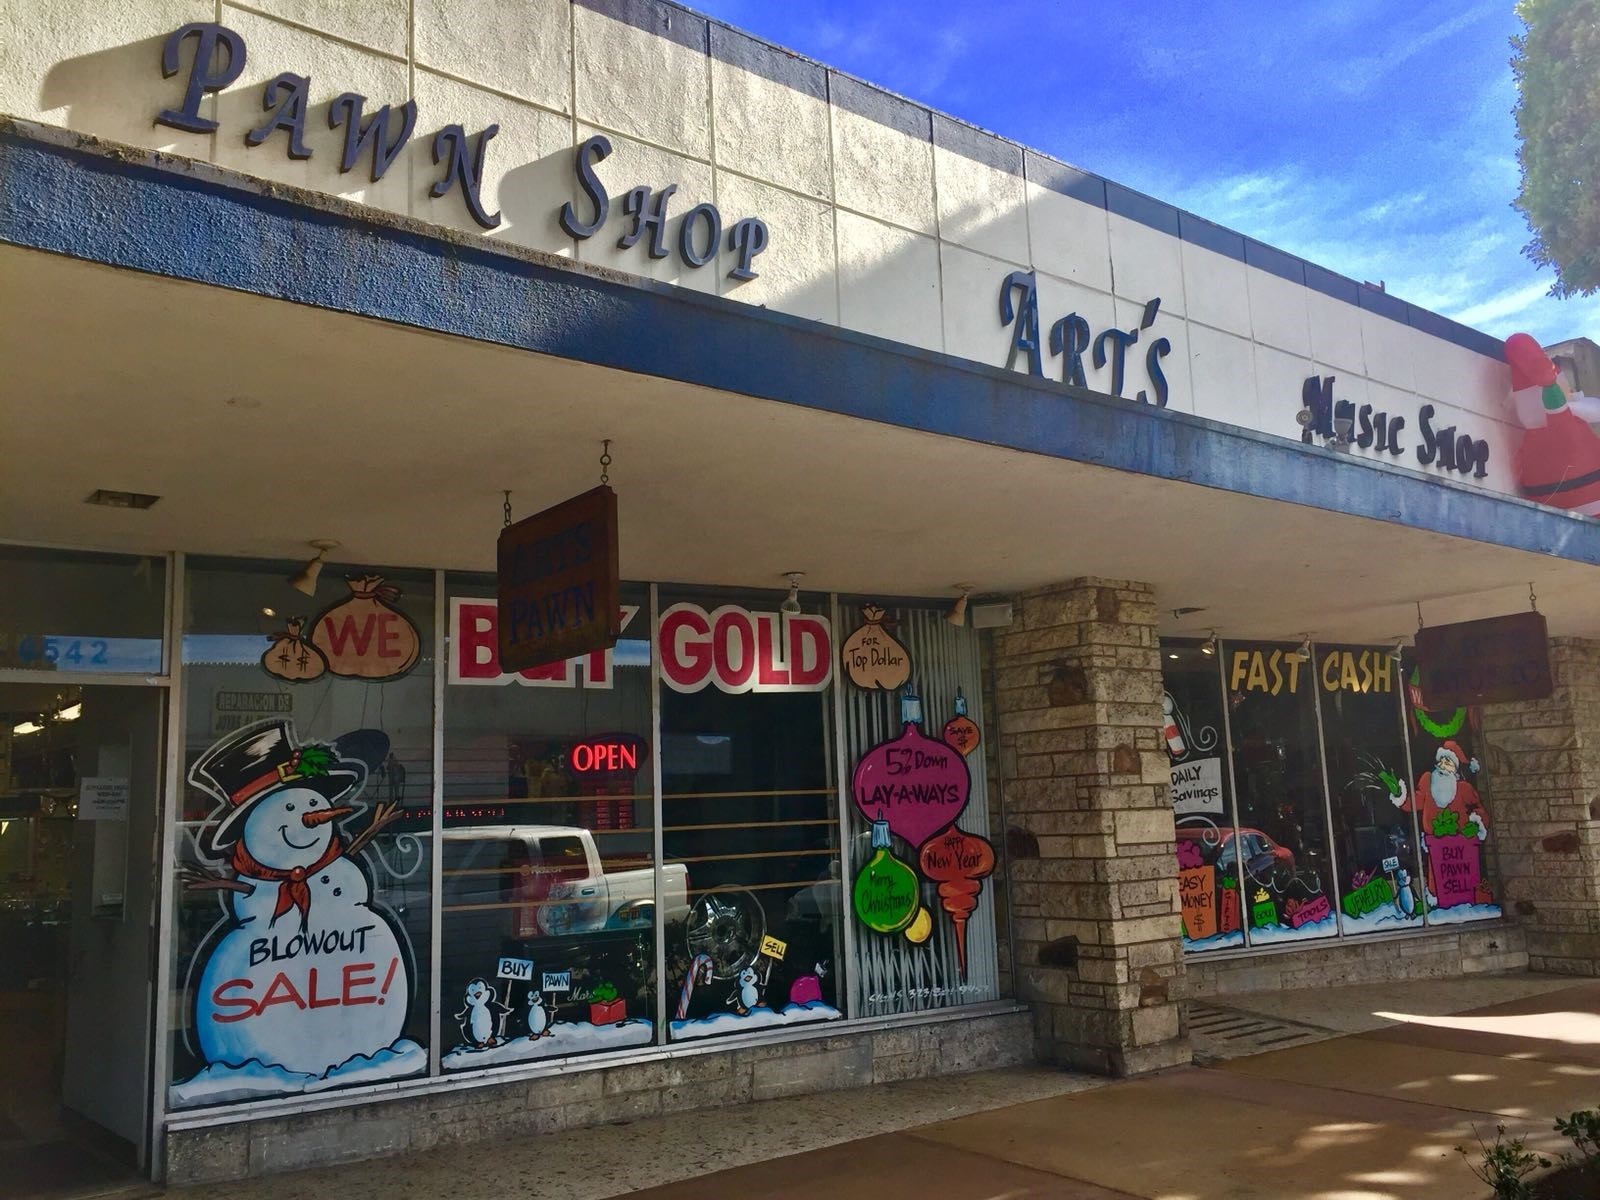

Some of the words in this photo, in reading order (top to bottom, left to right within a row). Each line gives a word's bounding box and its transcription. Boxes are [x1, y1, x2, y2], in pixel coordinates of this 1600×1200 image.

[153, 21, 501, 229] PAWN
[558, 134, 769, 282] SHOP
[999, 270, 1171, 408] ART'S
[1417, 404, 1490, 478] SHOP
[510, 579, 595, 646] PAWN
[324, 613, 401, 659] WE
[861, 637, 880, 647] FOR
[659, 609, 831, 688] GOLD
[849, 647, 868, 671] Top
[870, 646, 904, 668] Dollar
[1230, 649, 1310, 696] FAST
[1322, 650, 1392, 694] CASH
[572, 743, 637, 772] OPEN
[914, 750, 948, 770] Down
[1170, 765, 1203, 788] DAILY
[1172, 784, 1219, 803] Savings
[927, 851, 952, 870] New
[954, 850, 983, 871] Year
[1442, 846, 1466, 863] BUY
[1440, 861, 1471, 876] PAWN
[1443, 880, 1471, 895] SELL
[1181, 891, 1214, 909] MONEY
[1297, 901, 1329, 924] TOOLS
[249, 925, 377, 968] BLOWOUT
[764, 942, 785, 957] SELL
[500, 960, 531, 976] BUY
[211, 957, 399, 1024] SALE!
[544, 974, 570, 990] PAWN
